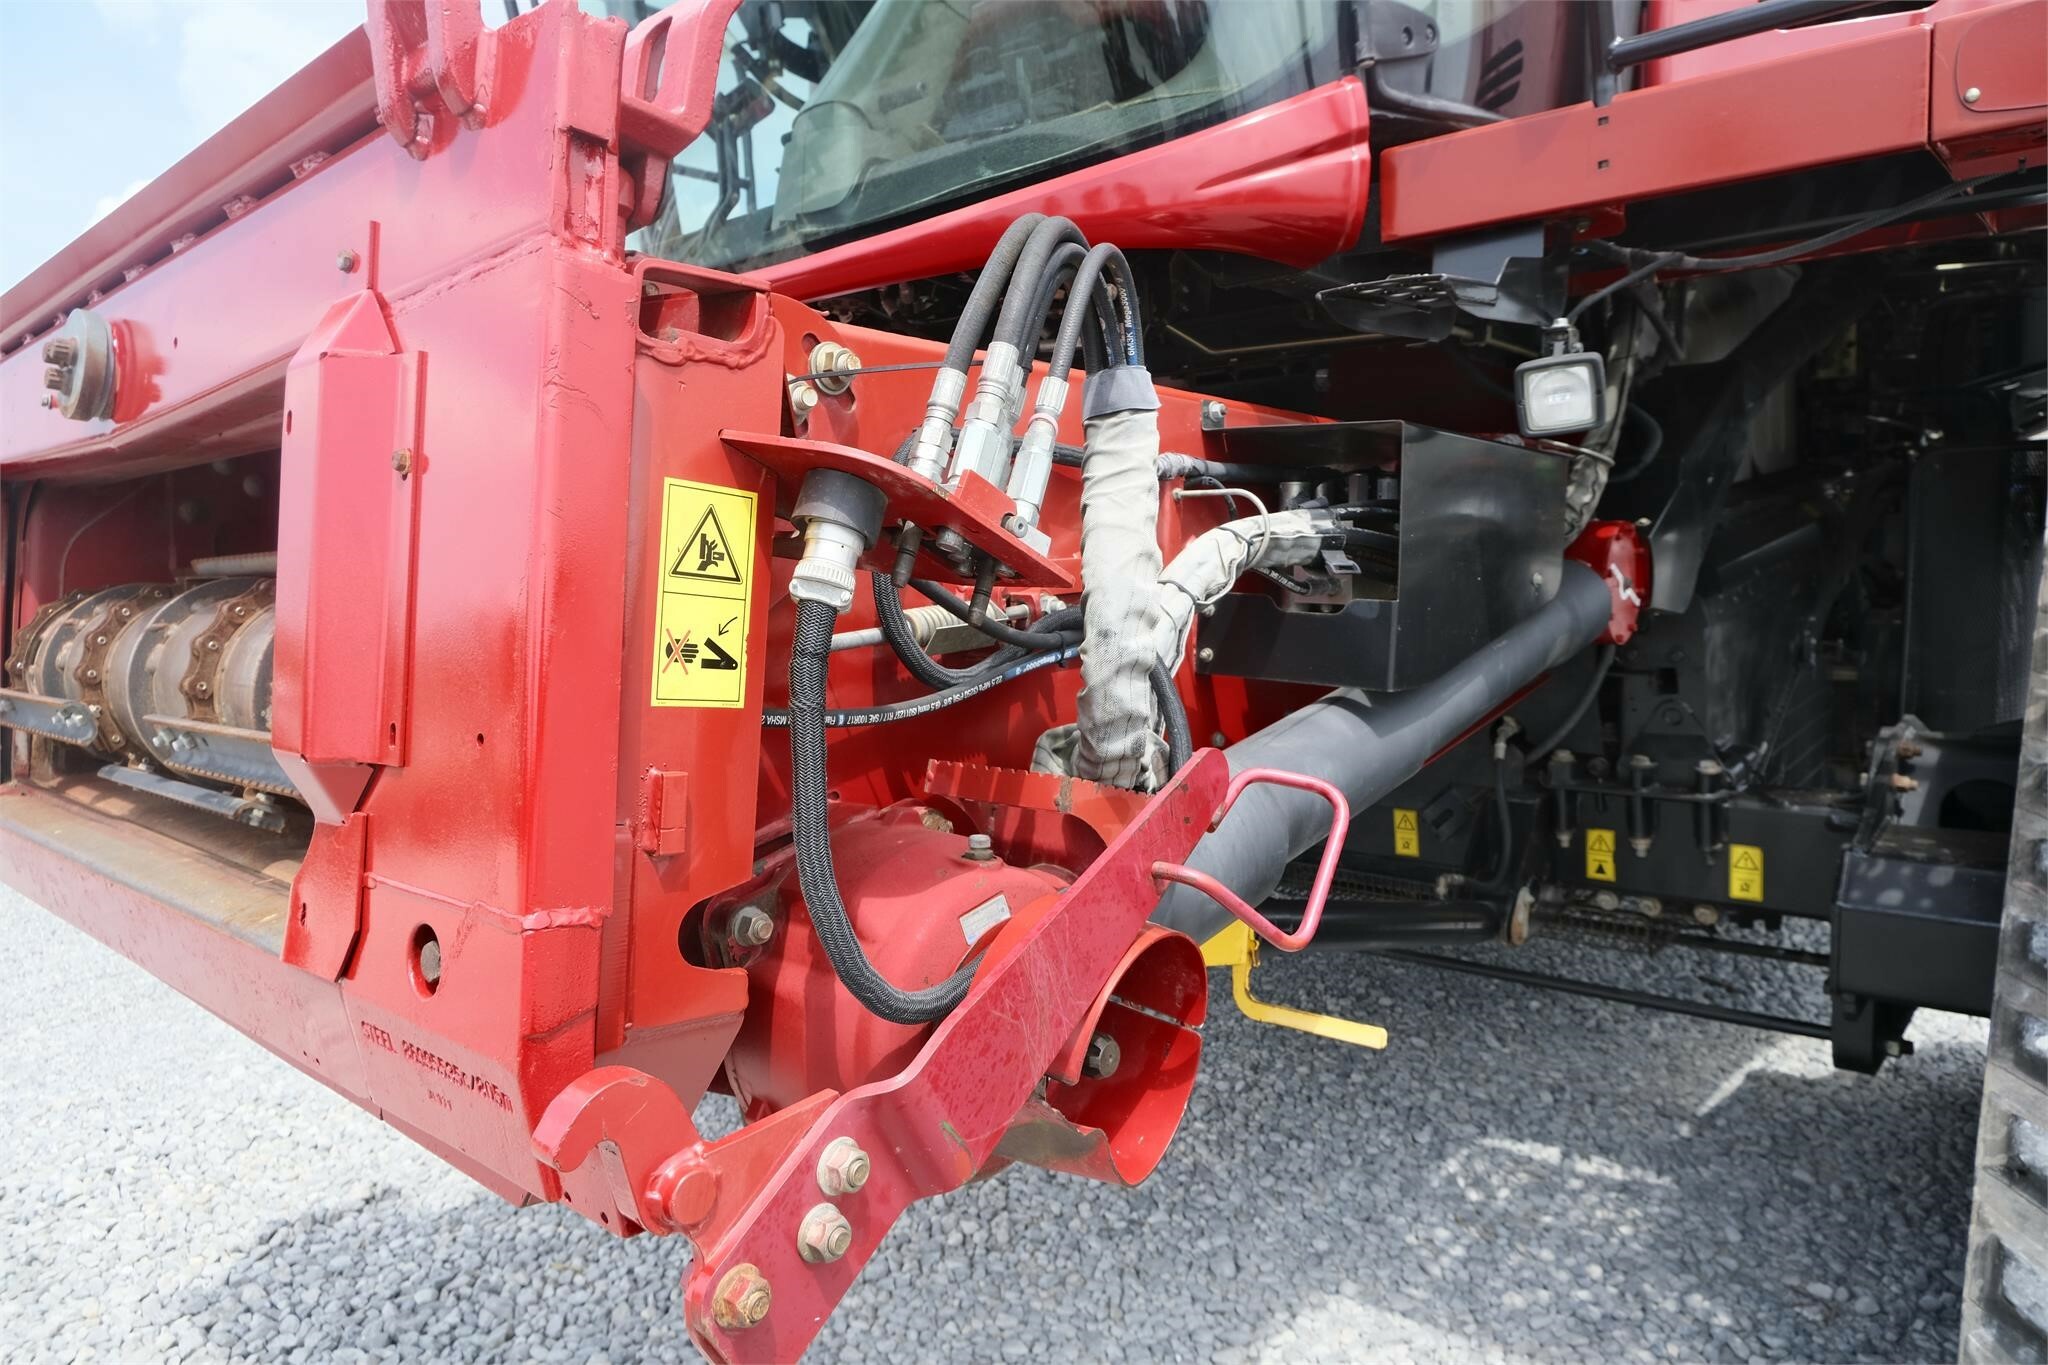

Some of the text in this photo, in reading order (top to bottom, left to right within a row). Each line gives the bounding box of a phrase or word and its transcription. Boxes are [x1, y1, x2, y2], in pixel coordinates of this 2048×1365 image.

[1126, 332, 1135, 356] 6M3K
[766, 715, 787, 725] MSHA
[846, 714, 868, 725] 100R17
[868, 713, 880, 724] SAE
[361, 1020, 398, 1054] STEEL
